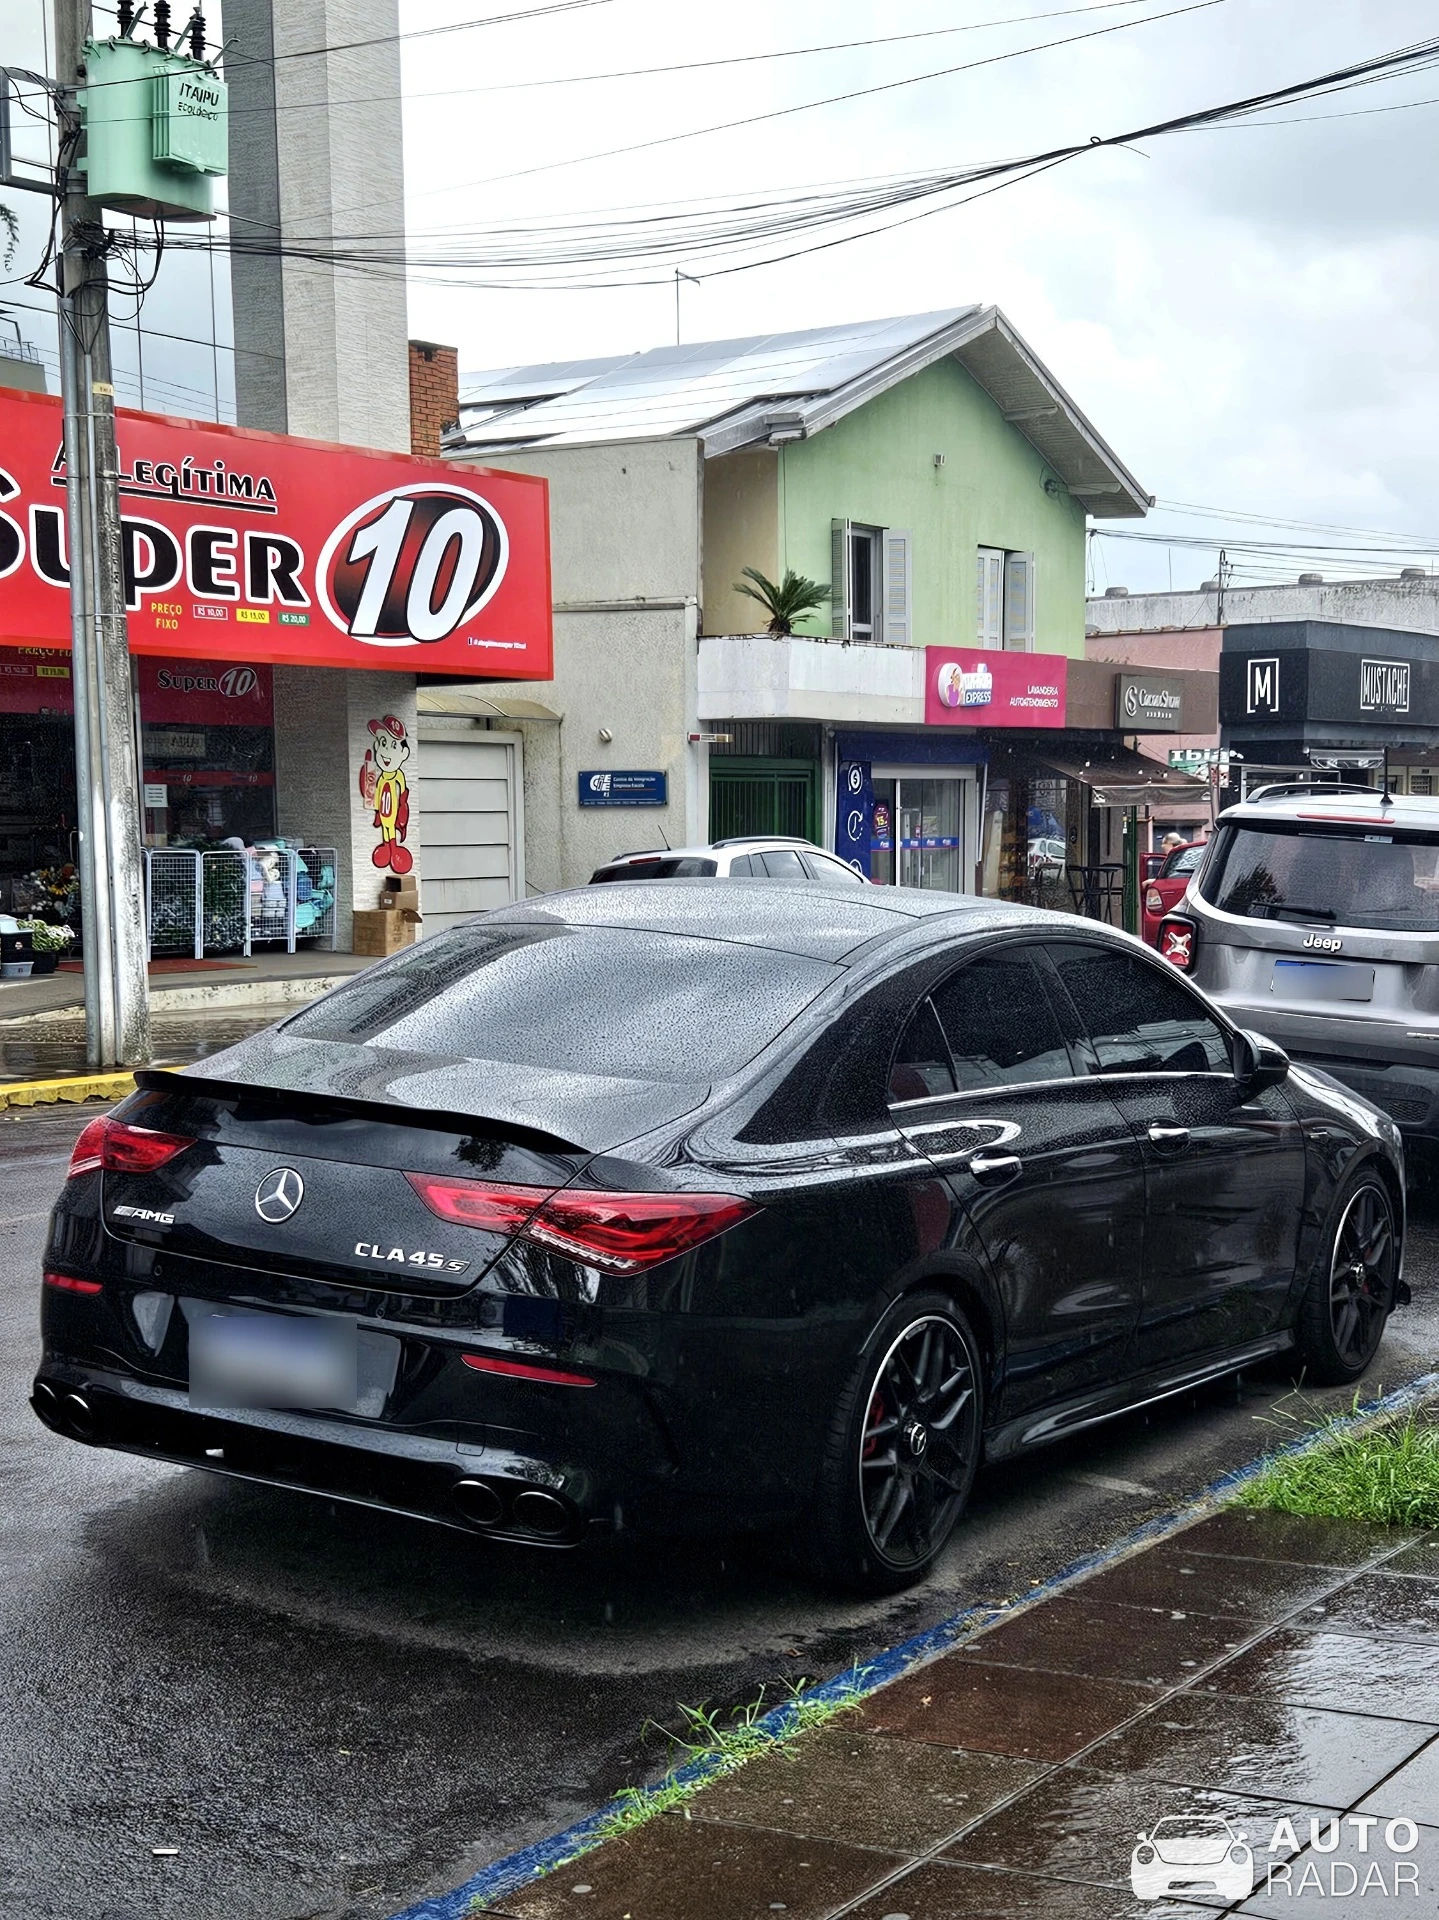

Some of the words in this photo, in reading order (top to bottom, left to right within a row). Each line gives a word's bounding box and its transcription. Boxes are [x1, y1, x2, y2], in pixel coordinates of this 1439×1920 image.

[180, 83, 219, 106] ITAIPU
[347, 496, 484, 643] 10
[151, 602, 183, 616] PREÇO
[156, 618, 179, 630] FIXO
[158, 668, 218, 693] SUPER
[224, 670, 252, 696] 10
[1255, 666, 1271, 706] M
[1363, 666, 1408, 705] MUSTACHE
[392, 720, 400, 731] 10
[381, 791, 391, 815] 10
[1303, 933, 1342, 953] Jeep
[131, 1209, 175, 1225] AMG
